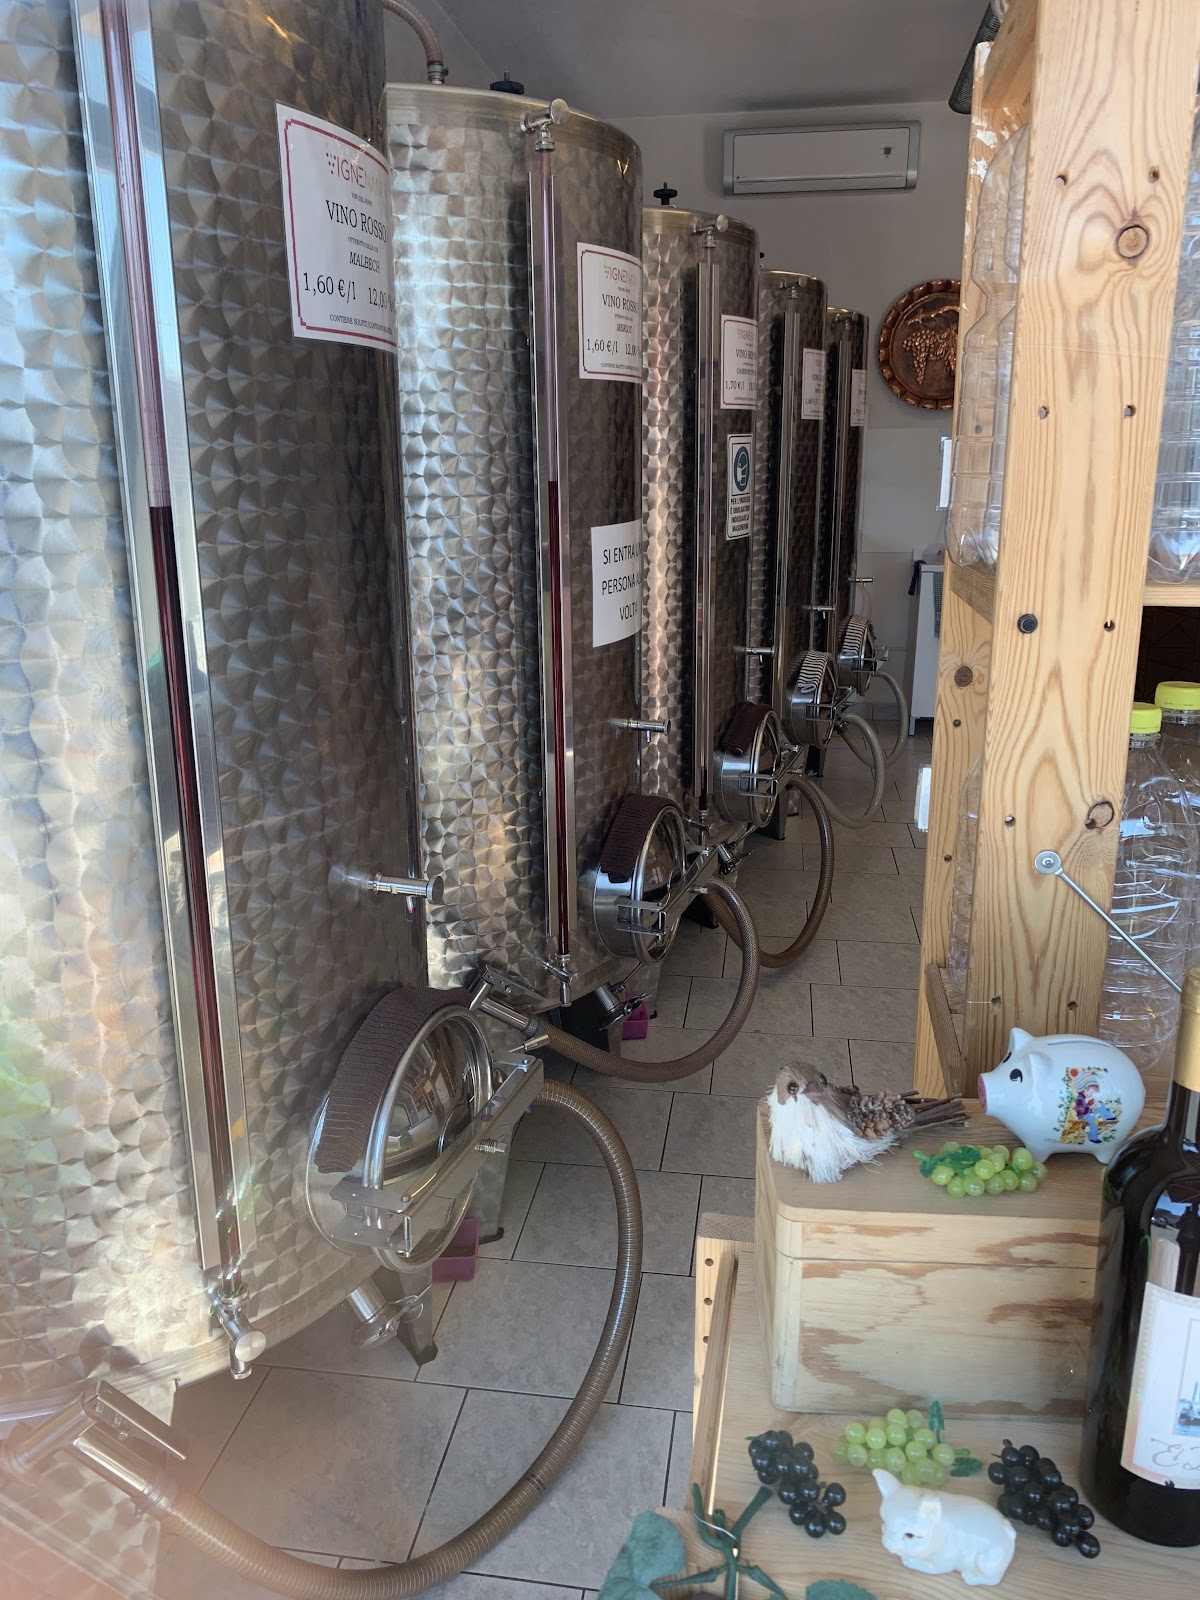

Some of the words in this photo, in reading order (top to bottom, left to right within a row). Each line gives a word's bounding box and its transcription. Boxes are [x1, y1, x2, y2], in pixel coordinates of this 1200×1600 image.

[325, 199, 358, 228] VINO
[360, 212, 387, 243] ROSSO
[349, 251, 381, 274] MALBECH
[303, 272, 334, 297] 1,60
[601, 293, 621, 309] VINO
[329, 314, 353, 326] CONTIENE
[586, 338, 605, 354] 1,60
[603, 549, 611, 565] SI
[613, 544, 636, 562] ENTRA
[602, 573, 636, 595] PERSONA
